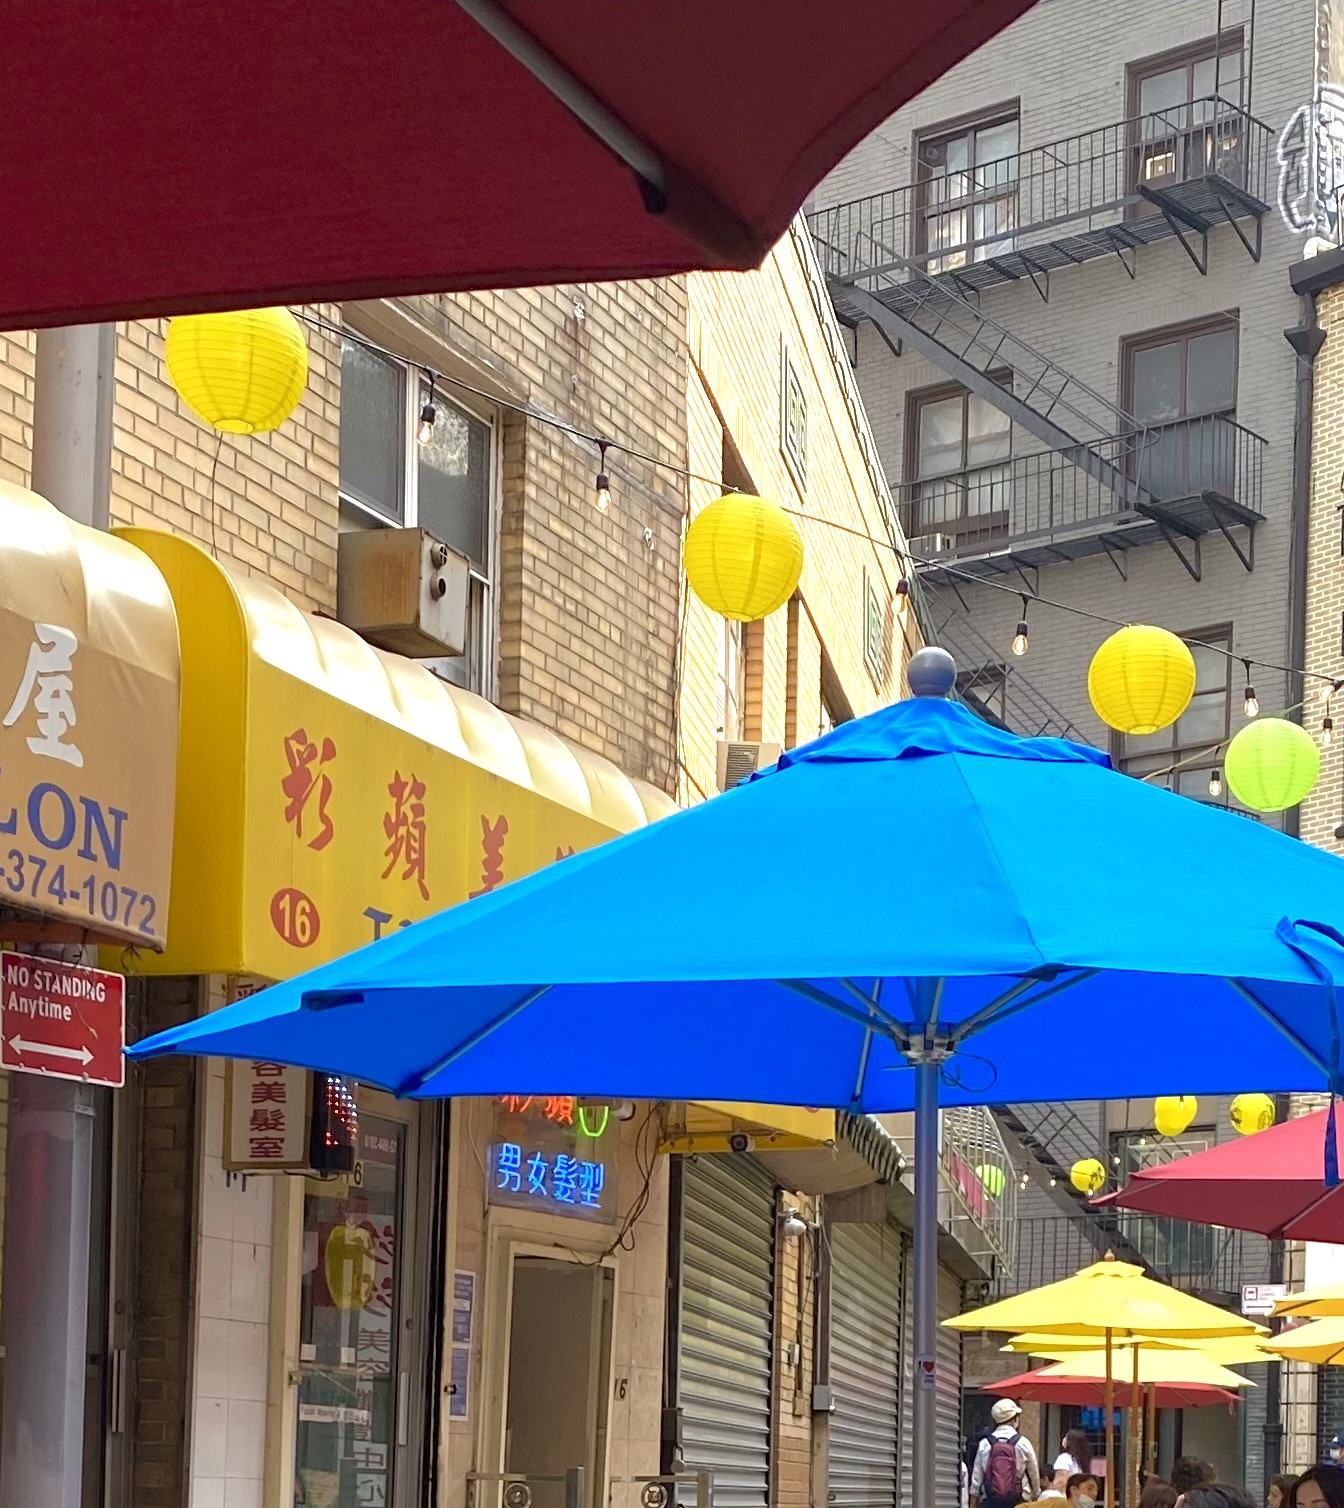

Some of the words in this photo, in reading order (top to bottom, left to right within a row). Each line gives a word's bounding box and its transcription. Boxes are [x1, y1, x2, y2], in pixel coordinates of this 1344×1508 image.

[281, 728, 576, 901] 彩蘋美
[279, 893, 311, 944] 16
[7, 964, 30, 987] NO
[33, 969, 106, 1002] STANDING
[8, 991, 72, 1021] Anytime
[497, 1142, 605, 1209] 男女髮型
